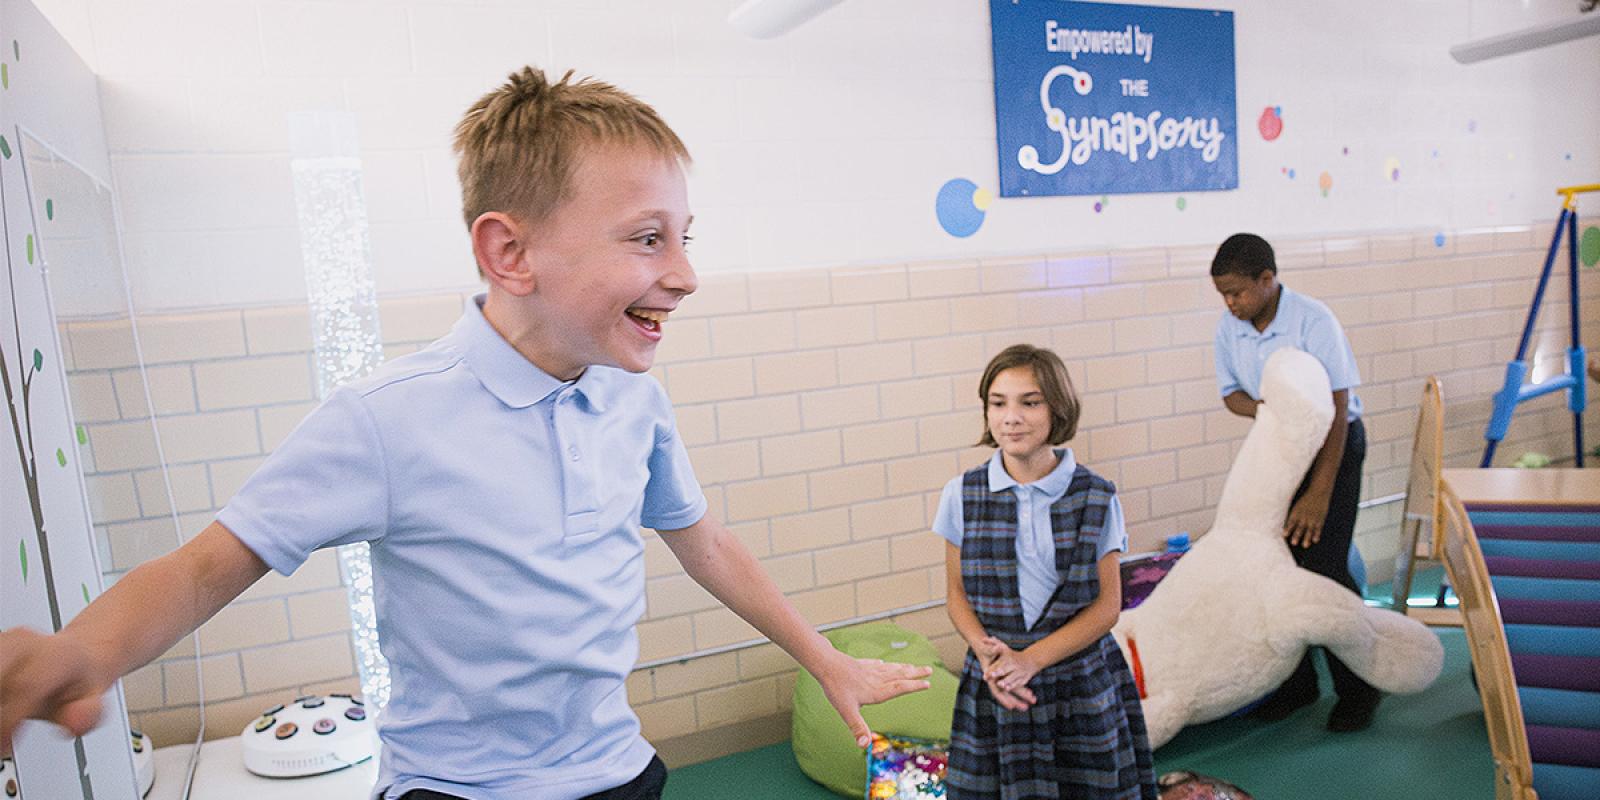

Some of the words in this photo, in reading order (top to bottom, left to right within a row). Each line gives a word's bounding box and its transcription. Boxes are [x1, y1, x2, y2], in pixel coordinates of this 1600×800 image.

[1046, 20, 1132, 60] Empowered
[1135, 25, 1153, 63] by
[1119, 79, 1149, 97] THE
[1018, 65, 1224, 175] Synapsory
